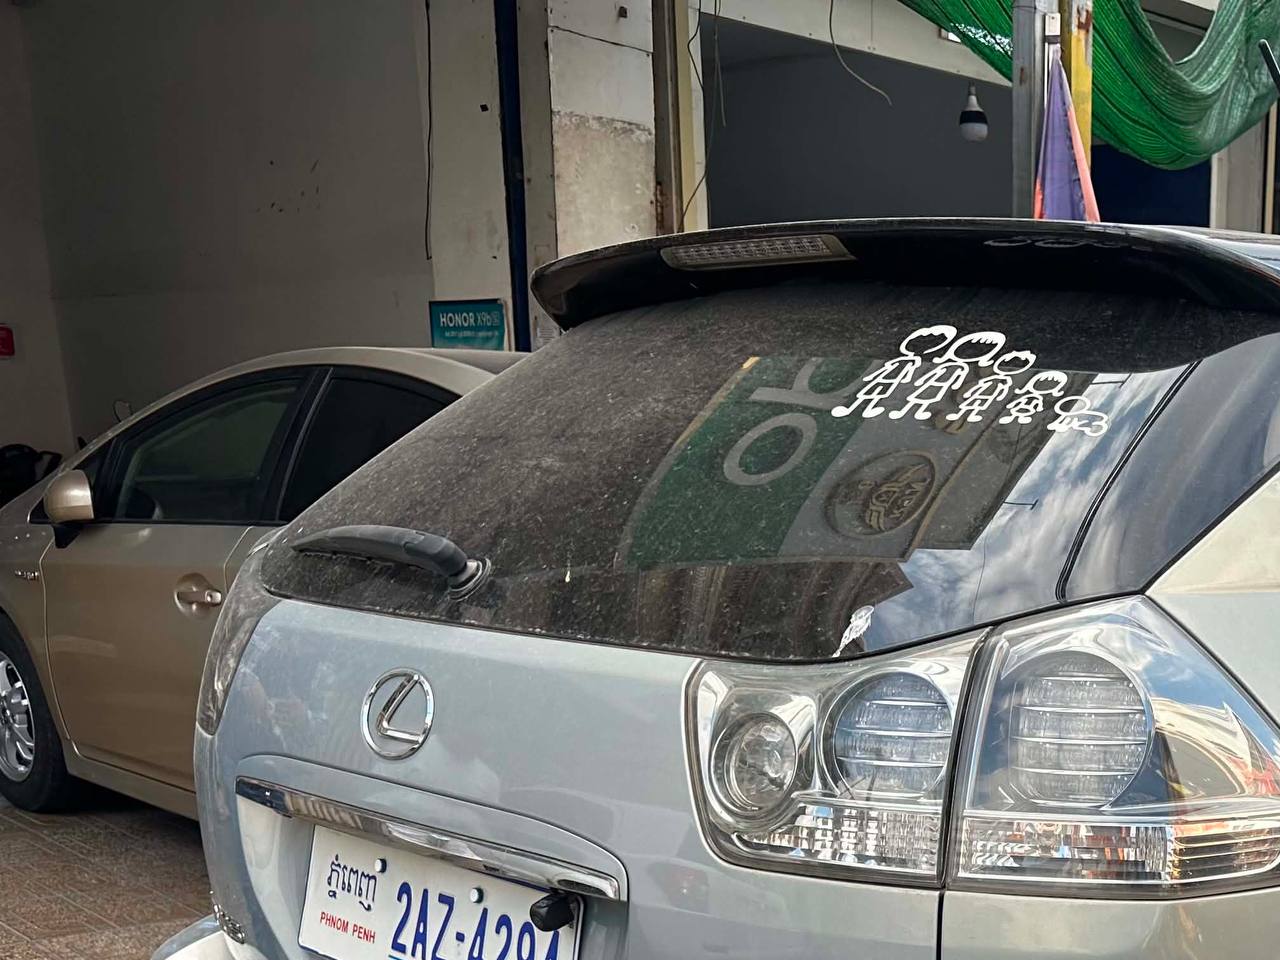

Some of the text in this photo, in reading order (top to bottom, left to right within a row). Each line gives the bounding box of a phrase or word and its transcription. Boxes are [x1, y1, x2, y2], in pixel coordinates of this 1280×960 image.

[440, 312, 475, 327] HONOR
[327, 853, 377, 912] ភ្នំពេញ
[319, 911, 376, 944] PHNOM PENH
